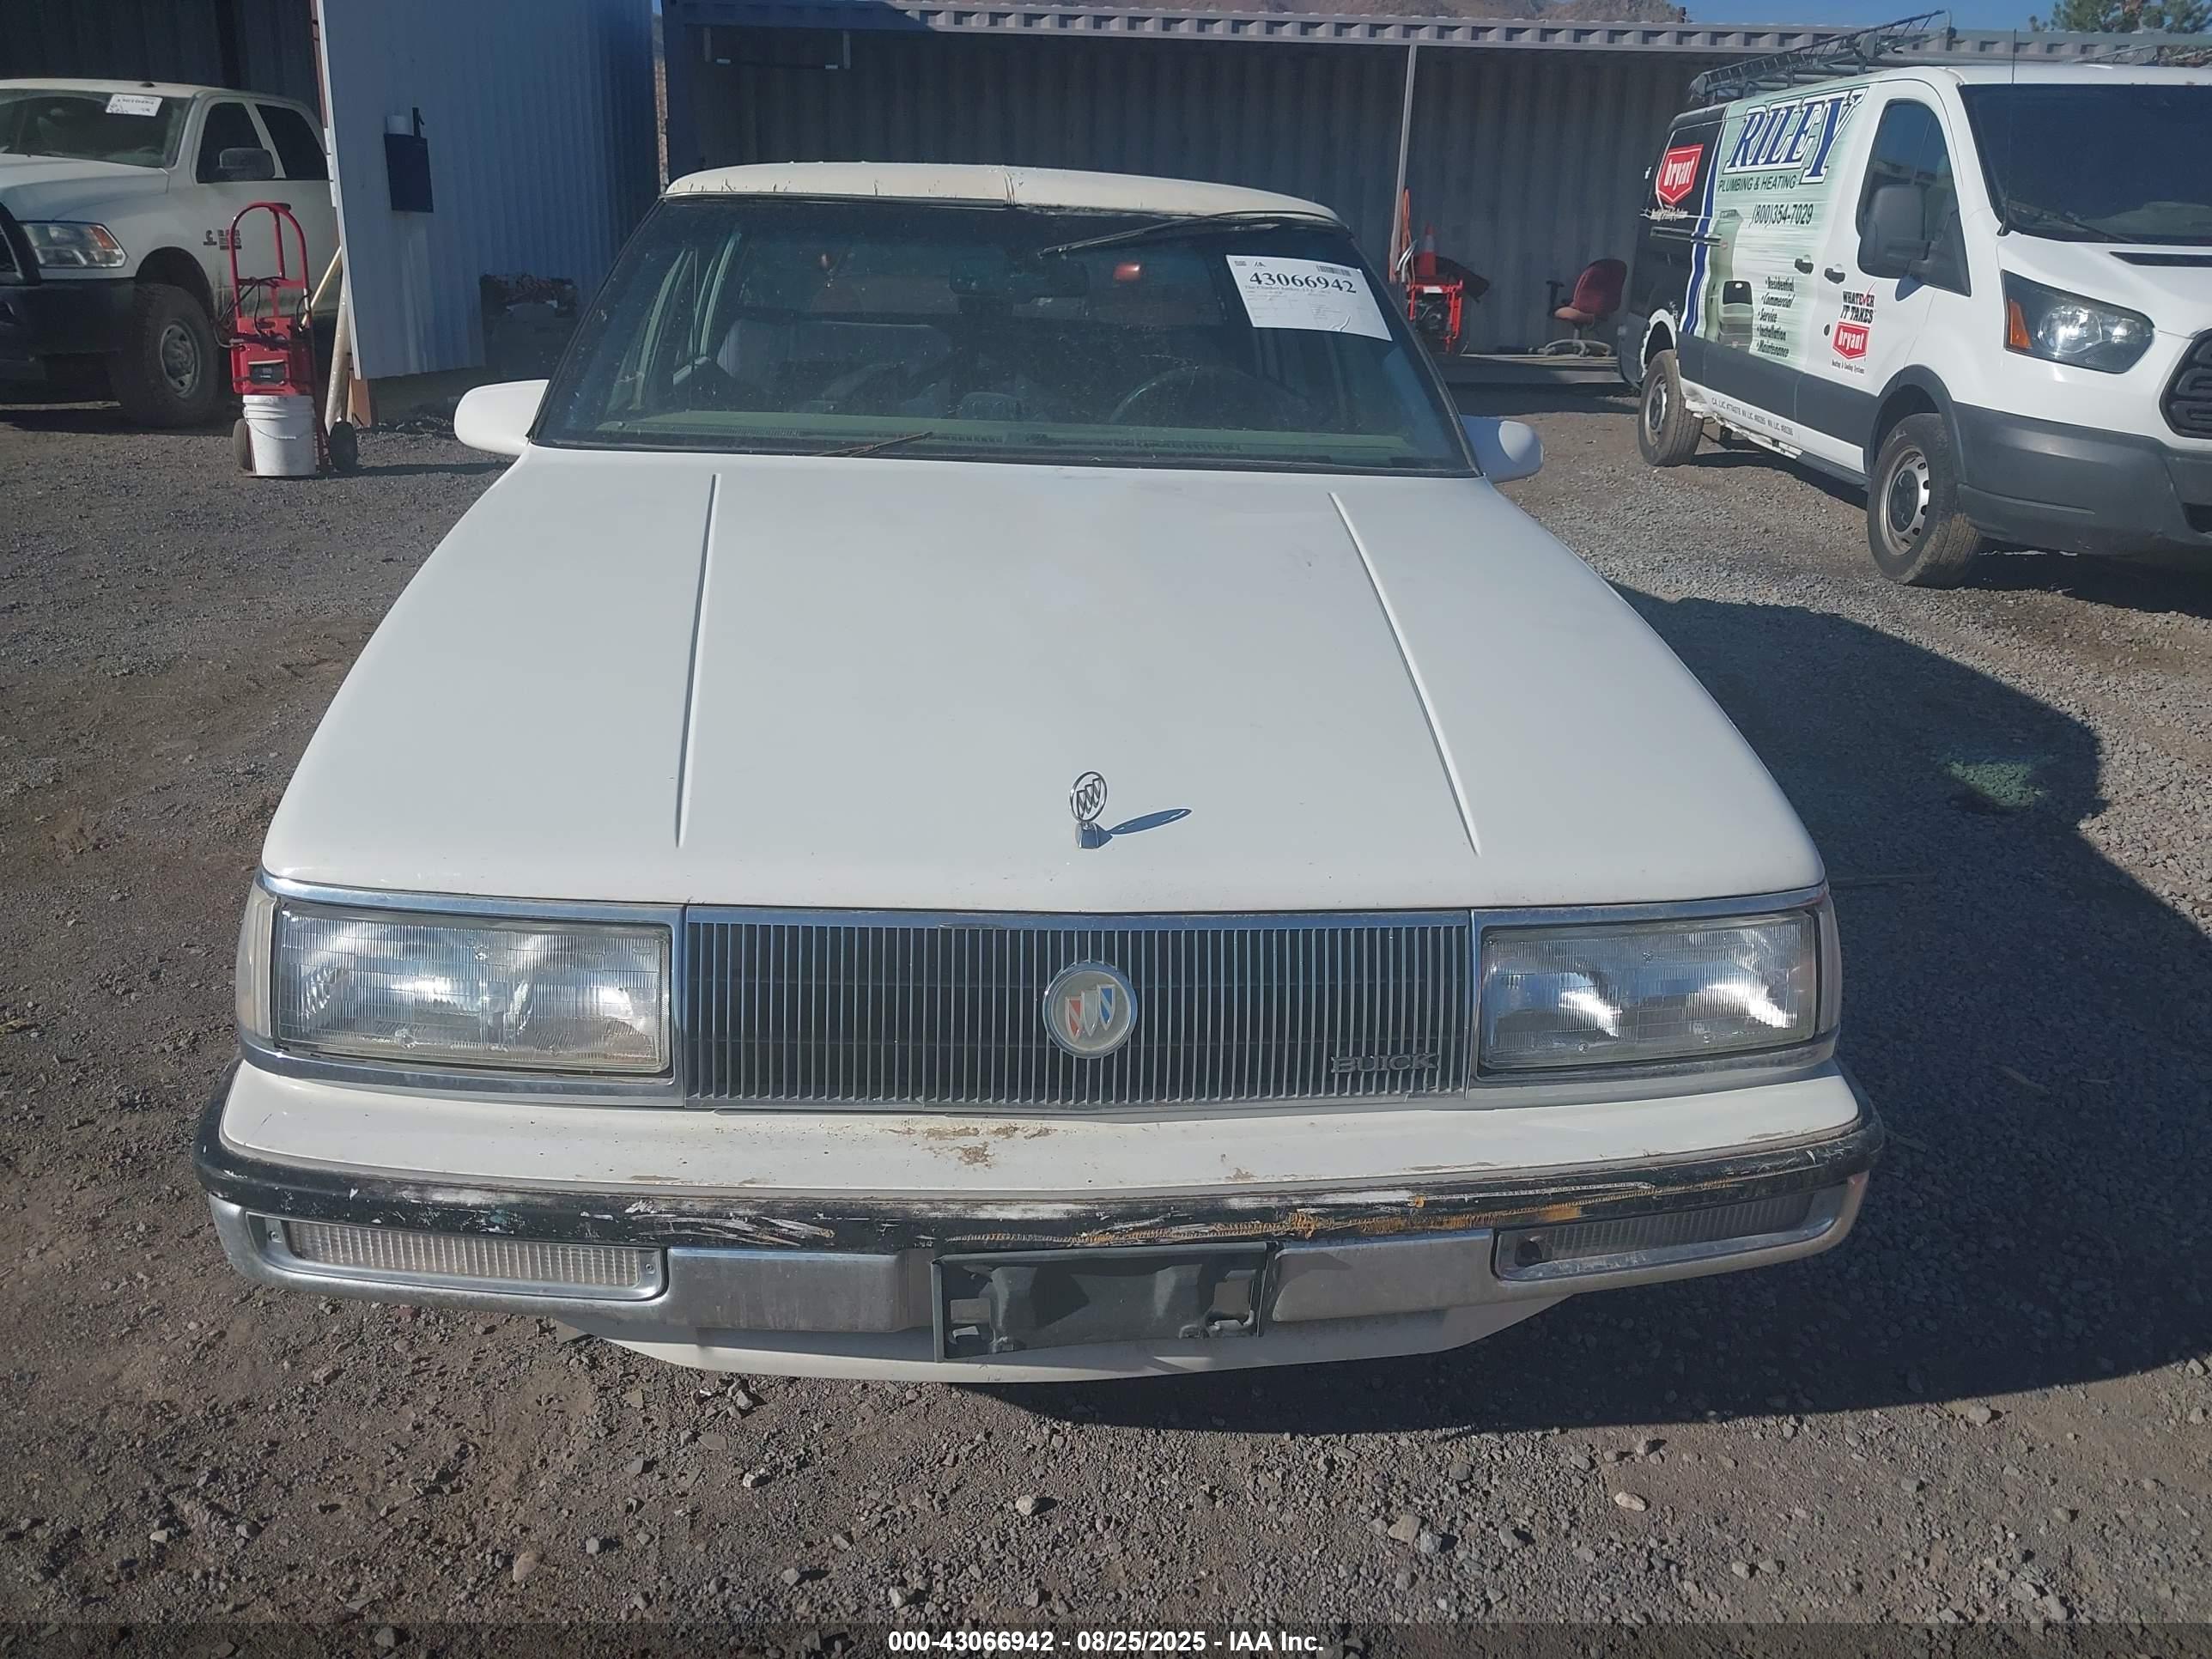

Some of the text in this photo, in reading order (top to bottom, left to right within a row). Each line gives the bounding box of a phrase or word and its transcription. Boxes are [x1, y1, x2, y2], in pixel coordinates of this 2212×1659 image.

[1723, 86, 1869, 185] RILEY
[1663, 156, 1695, 191] bryant
[1717, 174, 1797, 192] PLUMBING & HEATING
[1749, 204, 1814, 228] (800)354-7029
[1250, 272, 1357, 294] 43066942
[1840, 305, 1874, 324] IT TAKES
[1838, 327, 1864, 350] bryant
[1331, 1053, 1437, 1073] BUICK
